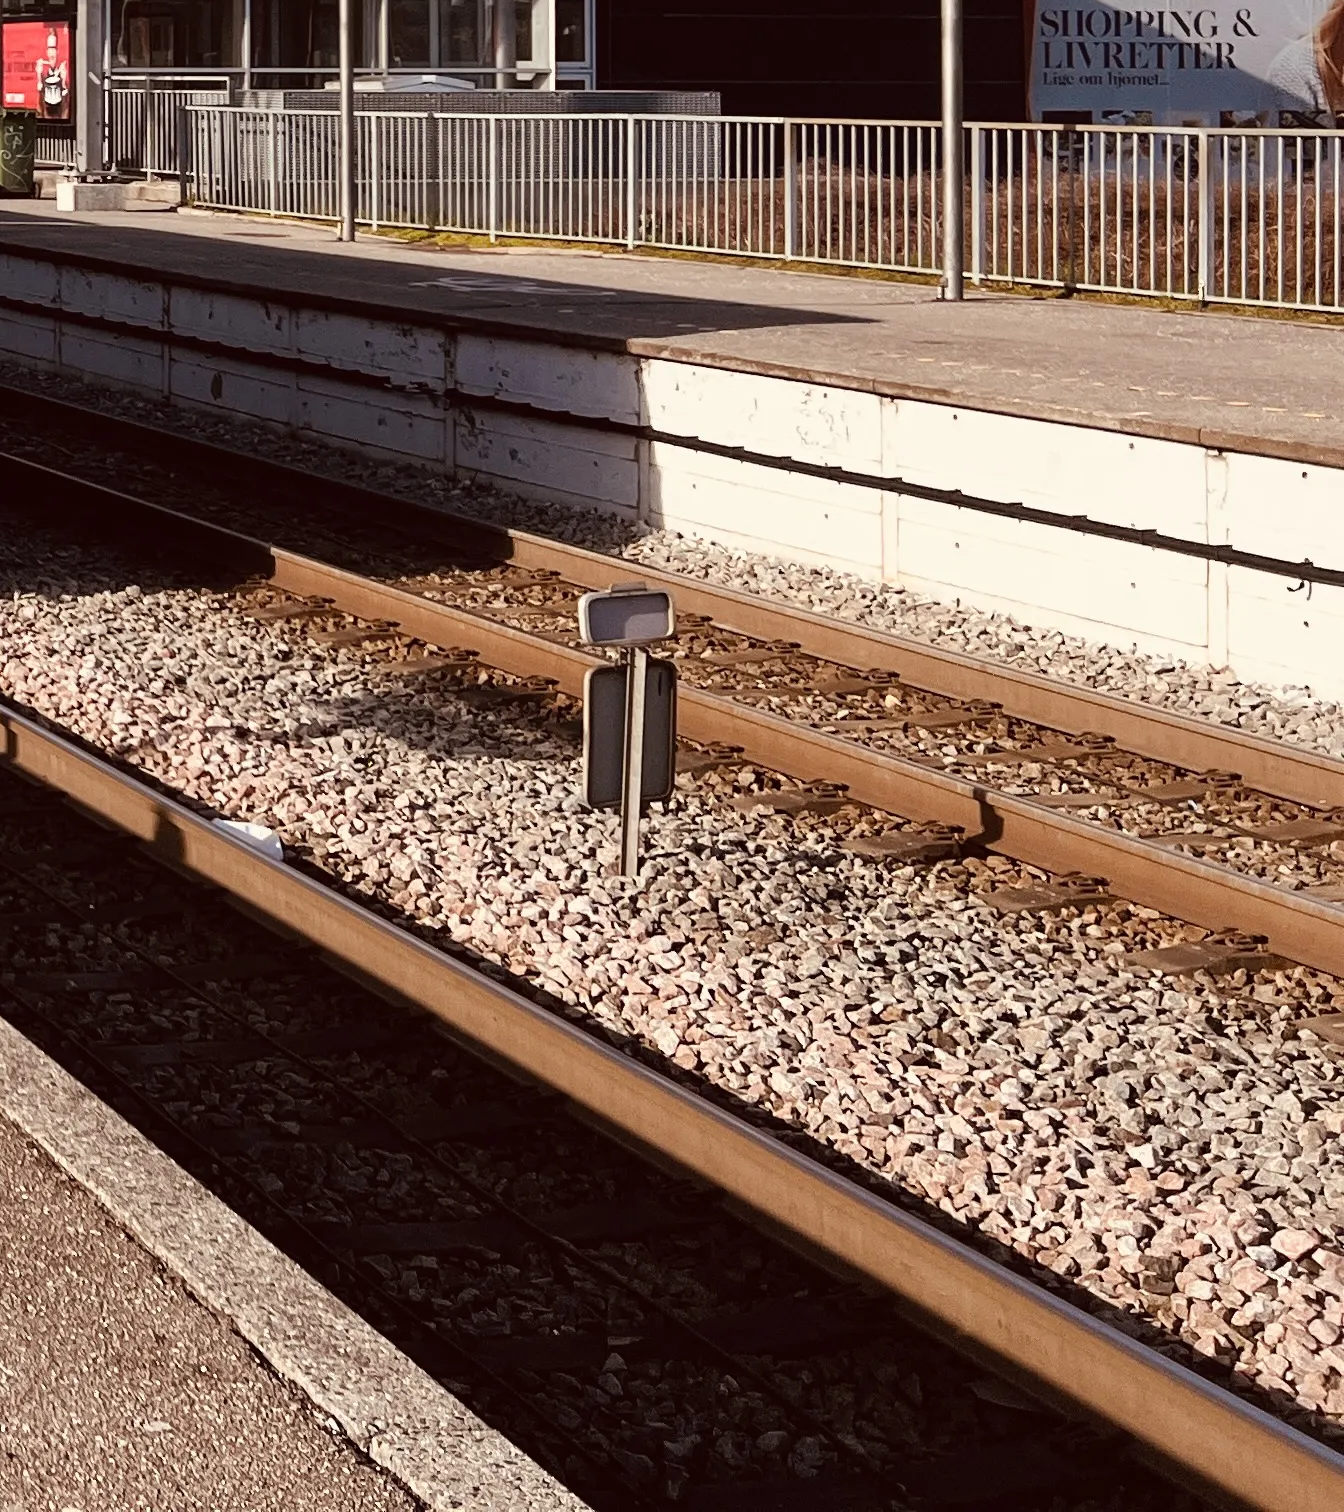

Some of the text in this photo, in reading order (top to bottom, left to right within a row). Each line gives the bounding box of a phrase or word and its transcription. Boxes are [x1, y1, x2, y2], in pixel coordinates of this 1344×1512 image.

[1040, 8, 1260, 38] SHOPPING &
[1042, 41, 1238, 70] LIVRETTER
[1043, 72, 1074, 85] Lige
[1079, 75, 1103, 85] om
